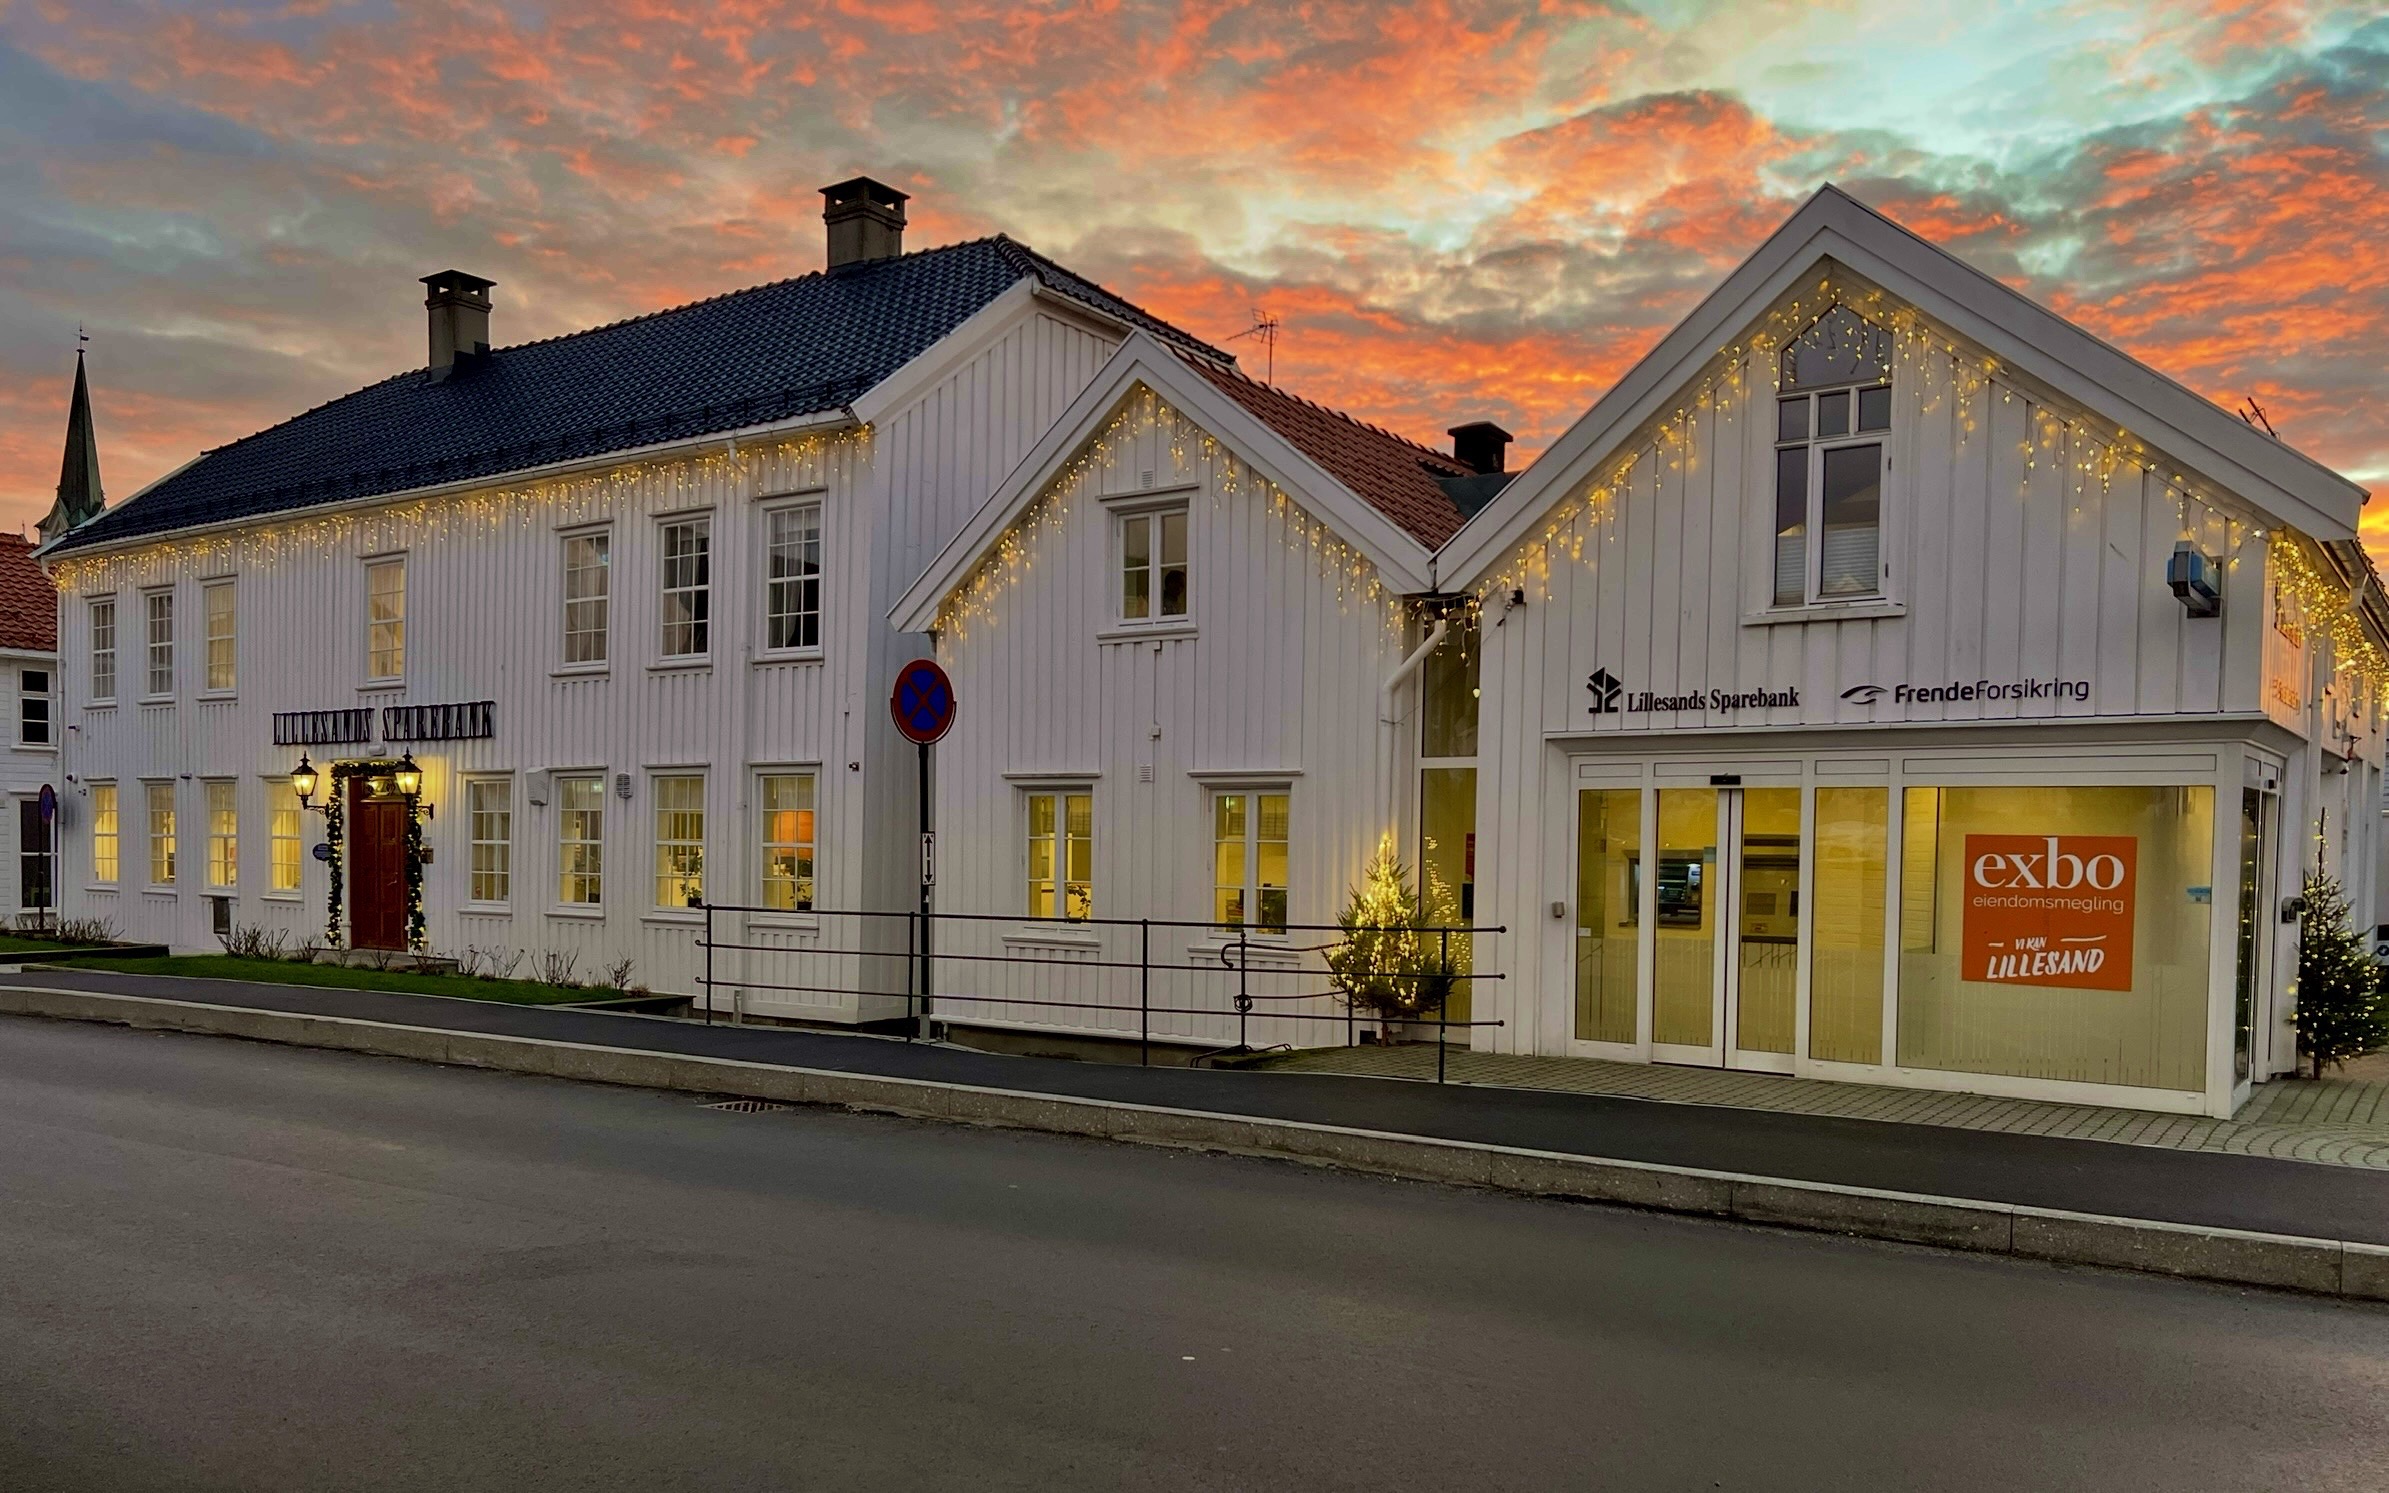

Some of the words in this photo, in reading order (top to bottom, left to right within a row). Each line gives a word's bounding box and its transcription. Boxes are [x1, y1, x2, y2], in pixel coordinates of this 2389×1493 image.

[1627, 690, 1706, 713] Lillesands
[1710, 686, 1800, 714] Sparebank
[1895, 677, 2089, 704] FrendeForsikring
[272, 707, 375, 745] LILLESANDS
[382, 700, 496, 742] SPAREBANK
[1973, 836, 2125, 890] exbo
[1973, 893, 2124, 915] eiendomsmegling
[2015, 938, 2025, 951] VI
[2026, 936, 2048, 951] KAN
[1986, 948, 2105, 979] LILLESAND
